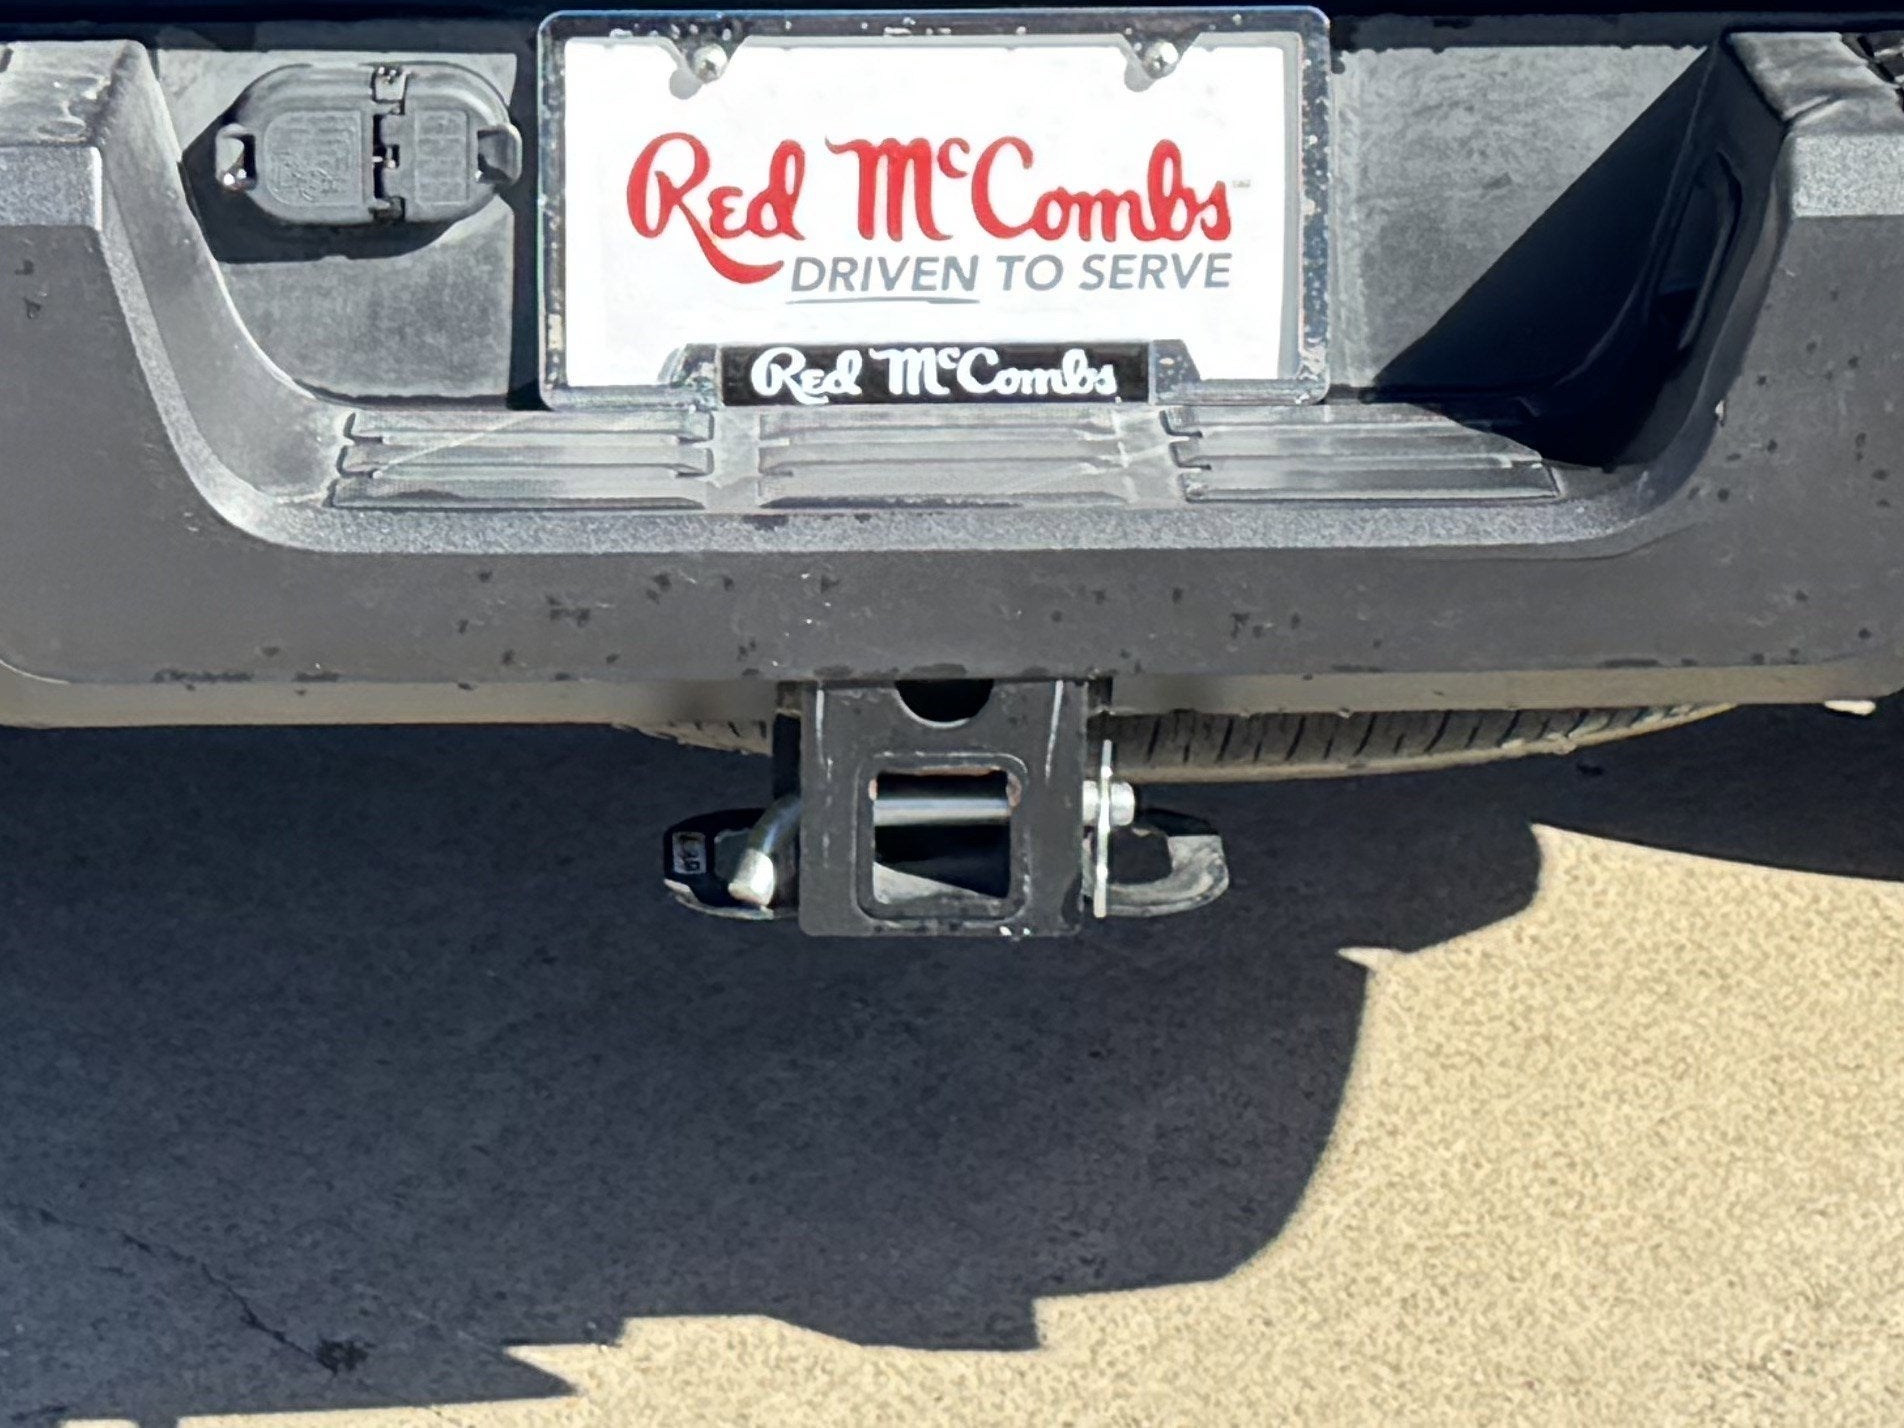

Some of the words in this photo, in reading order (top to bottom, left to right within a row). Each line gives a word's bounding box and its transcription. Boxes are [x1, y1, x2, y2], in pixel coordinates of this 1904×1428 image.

[626, 131, 806, 284] Red
[824, 135, 1232, 242] McCombs
[790, 254, 979, 294] DRIVEN
[996, 254, 1064, 292] TO
[1079, 251, 1233, 291] SERVE
[750, 346, 863, 405] Red
[869, 345, 1118, 397] McCombs
